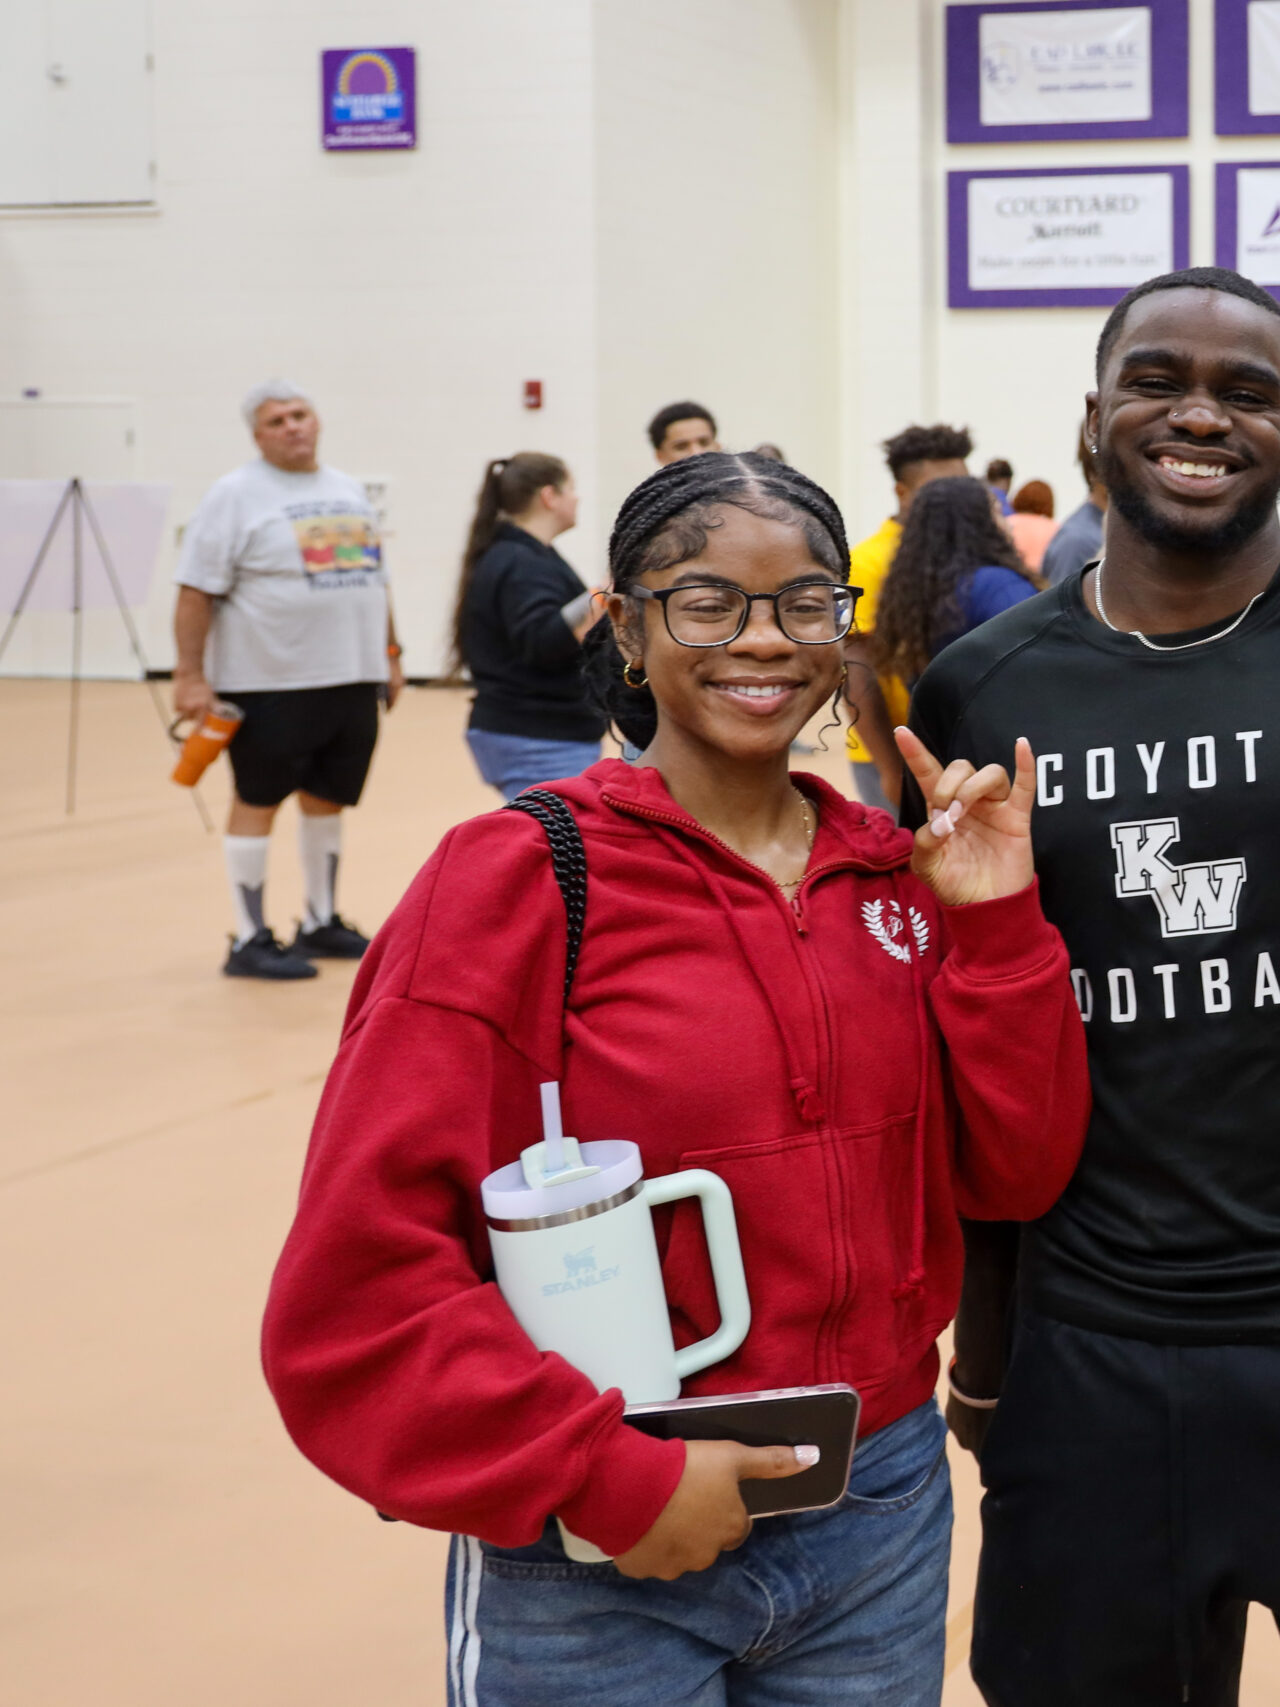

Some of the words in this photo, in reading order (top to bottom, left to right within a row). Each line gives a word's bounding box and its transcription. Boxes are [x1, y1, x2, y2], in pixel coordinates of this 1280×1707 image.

[996, 194, 1139, 217] COURTYARD
[1110, 817, 1247, 938] KW
[542, 1264, 621, 1297] STANLEY
